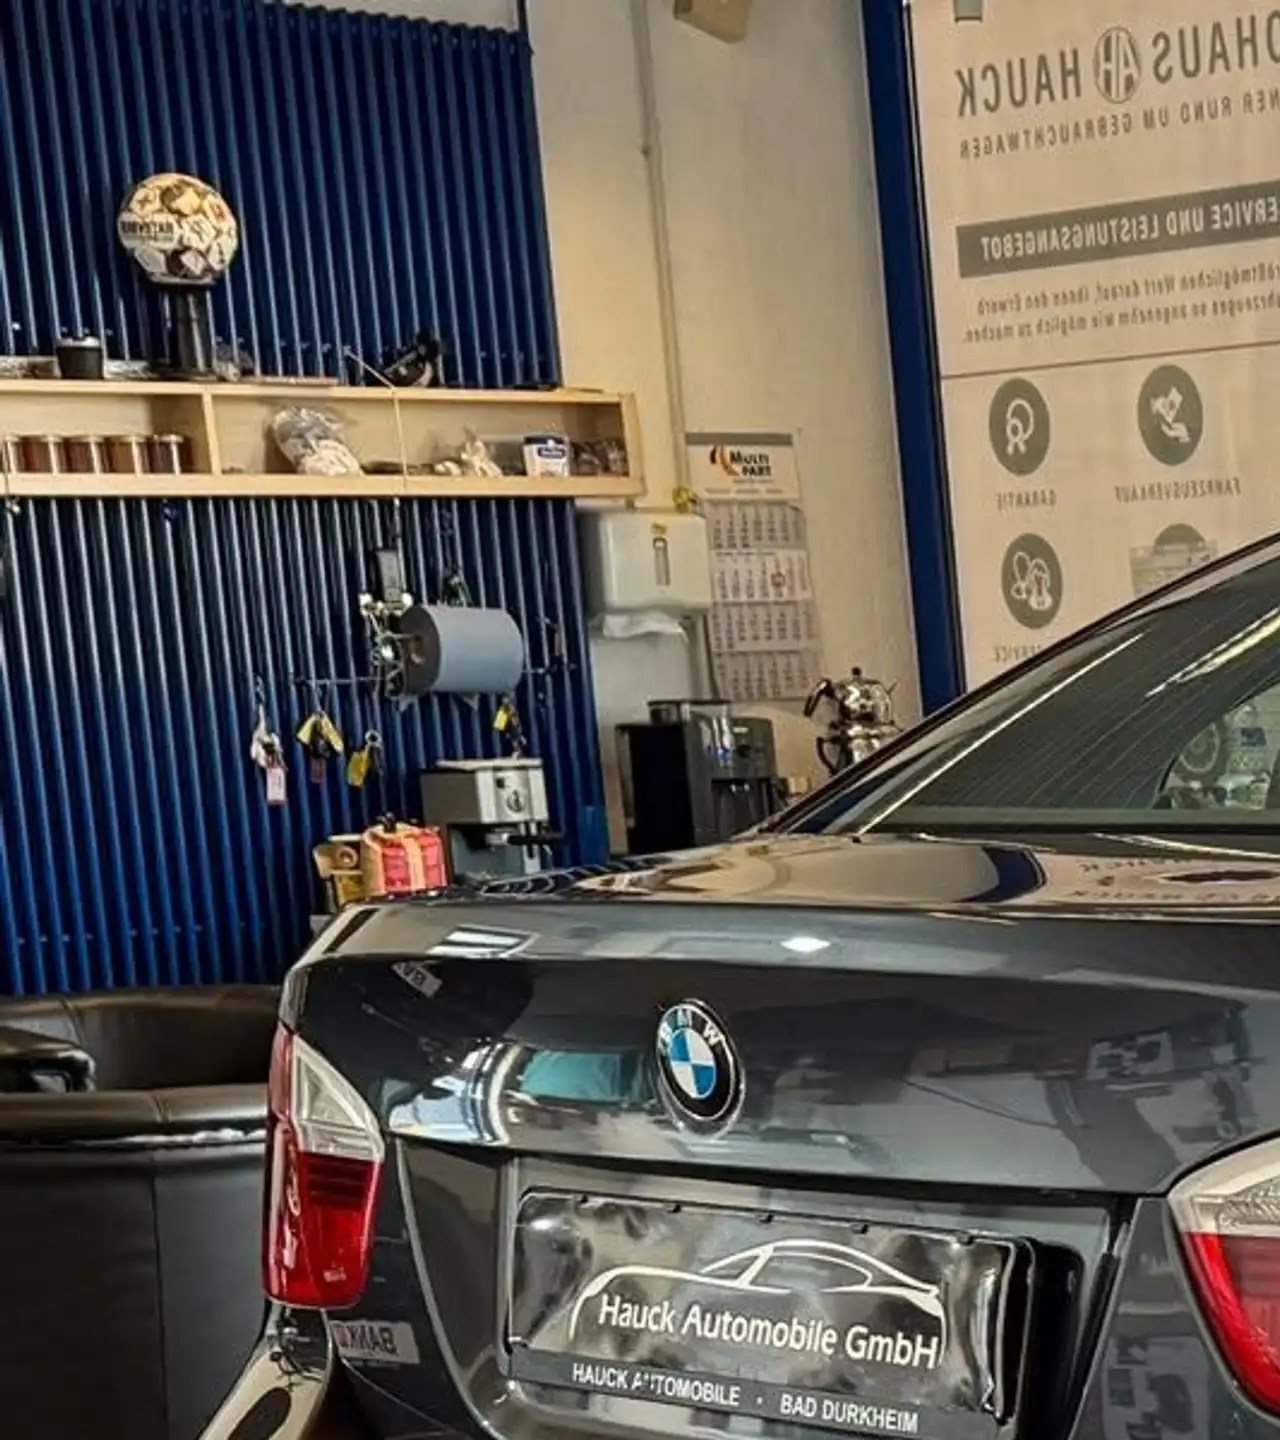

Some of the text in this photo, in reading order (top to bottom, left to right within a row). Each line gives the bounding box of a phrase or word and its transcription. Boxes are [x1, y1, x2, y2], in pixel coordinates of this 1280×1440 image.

[598, 1296, 939, 1370] Hauck Automobile GmbH
[572, 1362, 628, 1390] HAUCK
[631, 1371, 741, 1407] ATOMOBILE
[780, 1393, 817, 1419] BAD
